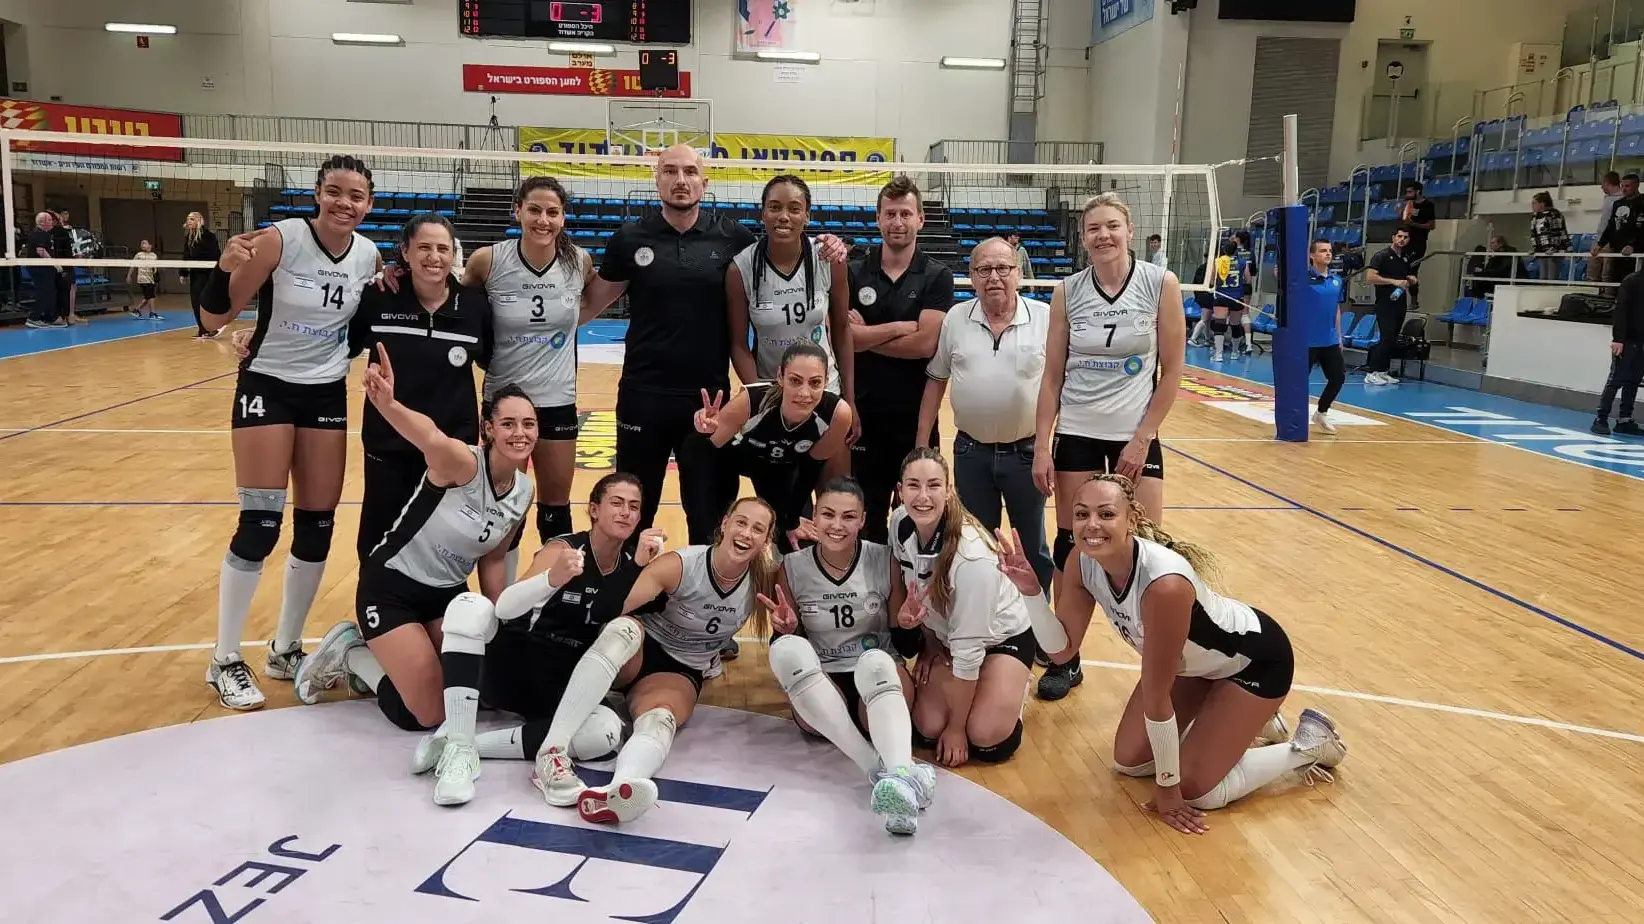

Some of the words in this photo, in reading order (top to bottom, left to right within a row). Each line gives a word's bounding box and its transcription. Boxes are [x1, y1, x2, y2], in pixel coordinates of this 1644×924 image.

[641, 52, 649, 65] 0
[486, 72, 522, 84] בישראל
[524, 76, 558, 85] הספורט
[559, 76, 581, 87] למען
[317, 269, 349, 279] GIVOVA
[321, 282, 345, 310] 14
[773, 287, 805, 296] GIVOVA
[531, 294, 545, 318] 3
[381, 313, 419, 321] GIVOVA
[781, 301, 806, 326] 19
[1093, 309, 1128, 317] GIVOVA
[1103, 323, 1117, 348] 7
[1092, 360, 1120, 369] קבוצת
[239, 393, 266, 419] 14
[770, 446, 784, 458] 8
[478, 520, 494, 543] 5
[822, 591, 858, 600] GIVOVA
[703, 603, 737, 614] GIVOVA
[365, 605, 380, 629] 5
[829, 604, 855, 629] 18
[705, 616, 721, 635] 6
